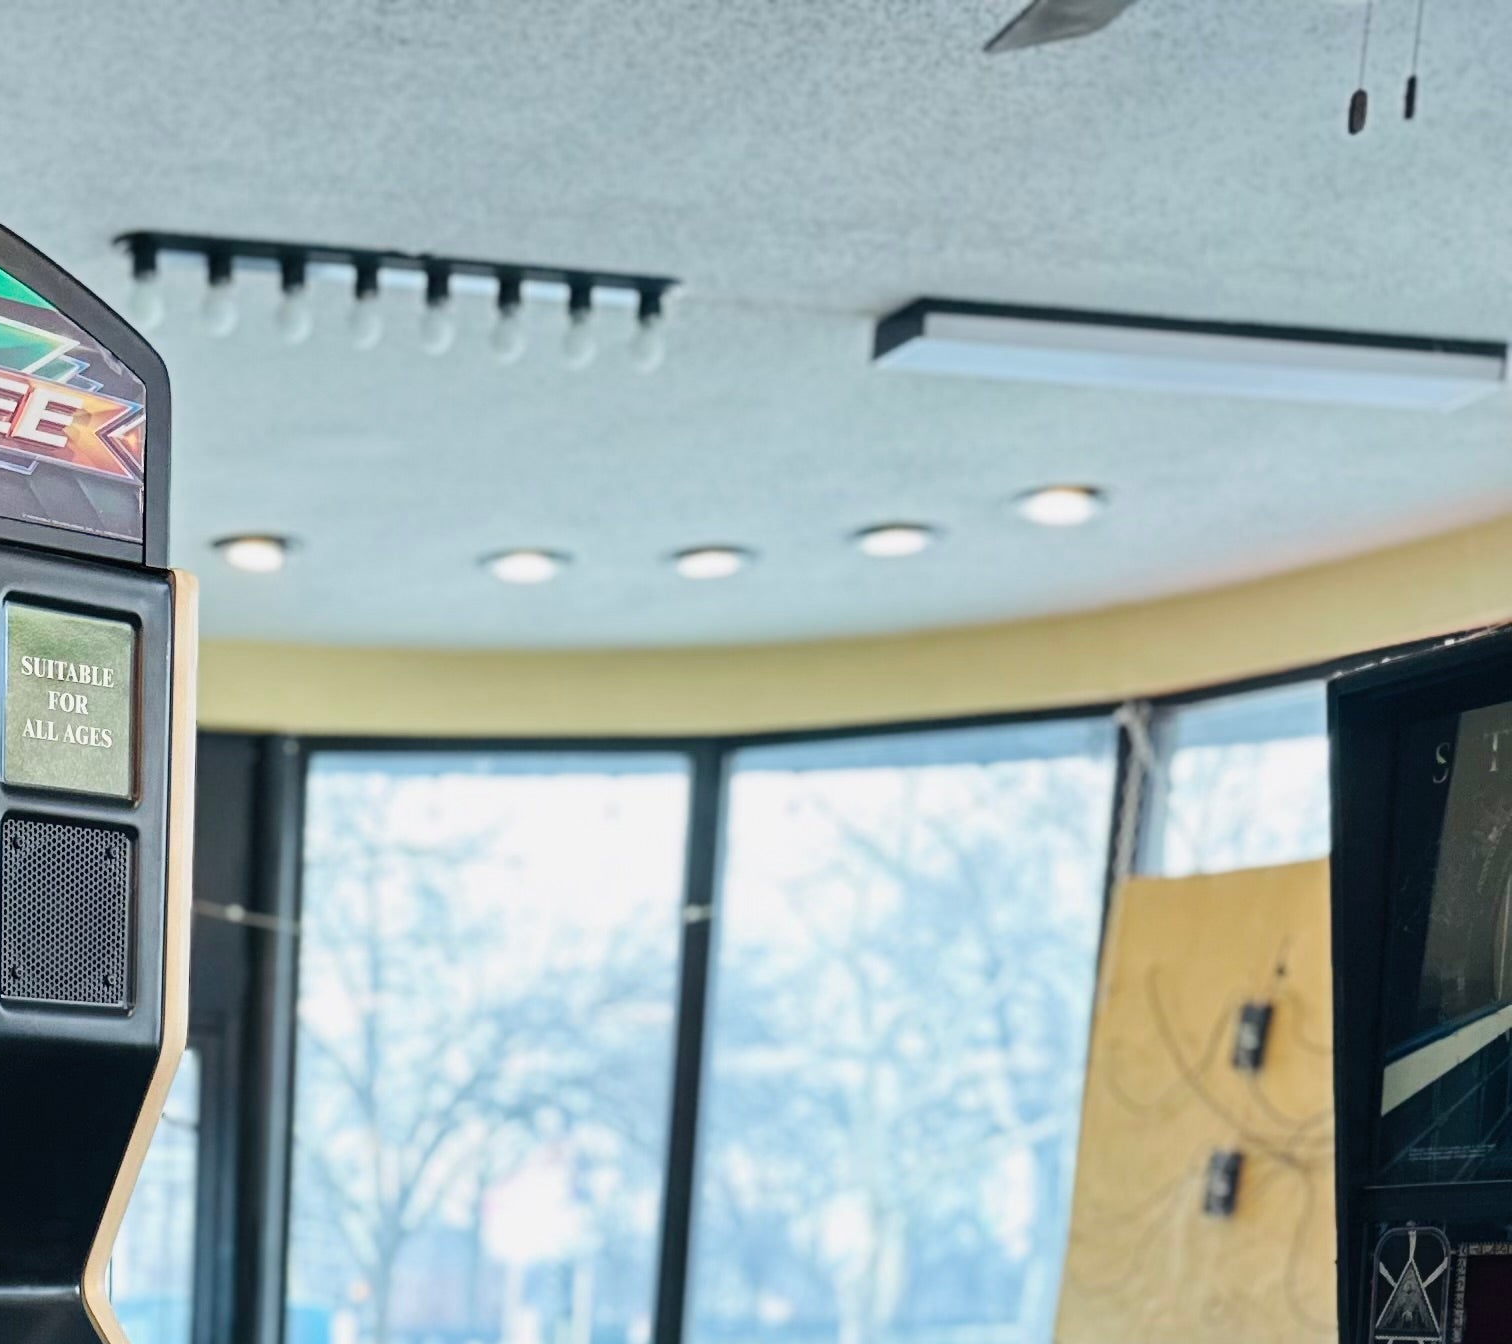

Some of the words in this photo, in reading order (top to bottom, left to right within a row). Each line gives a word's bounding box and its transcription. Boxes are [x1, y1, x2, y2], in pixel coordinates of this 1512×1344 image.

[21, 655, 115, 689] SUITABLE
[47, 690, 89, 716] FOR
[22, 718, 59, 743] ALL
[62, 723, 114, 750] AGES
